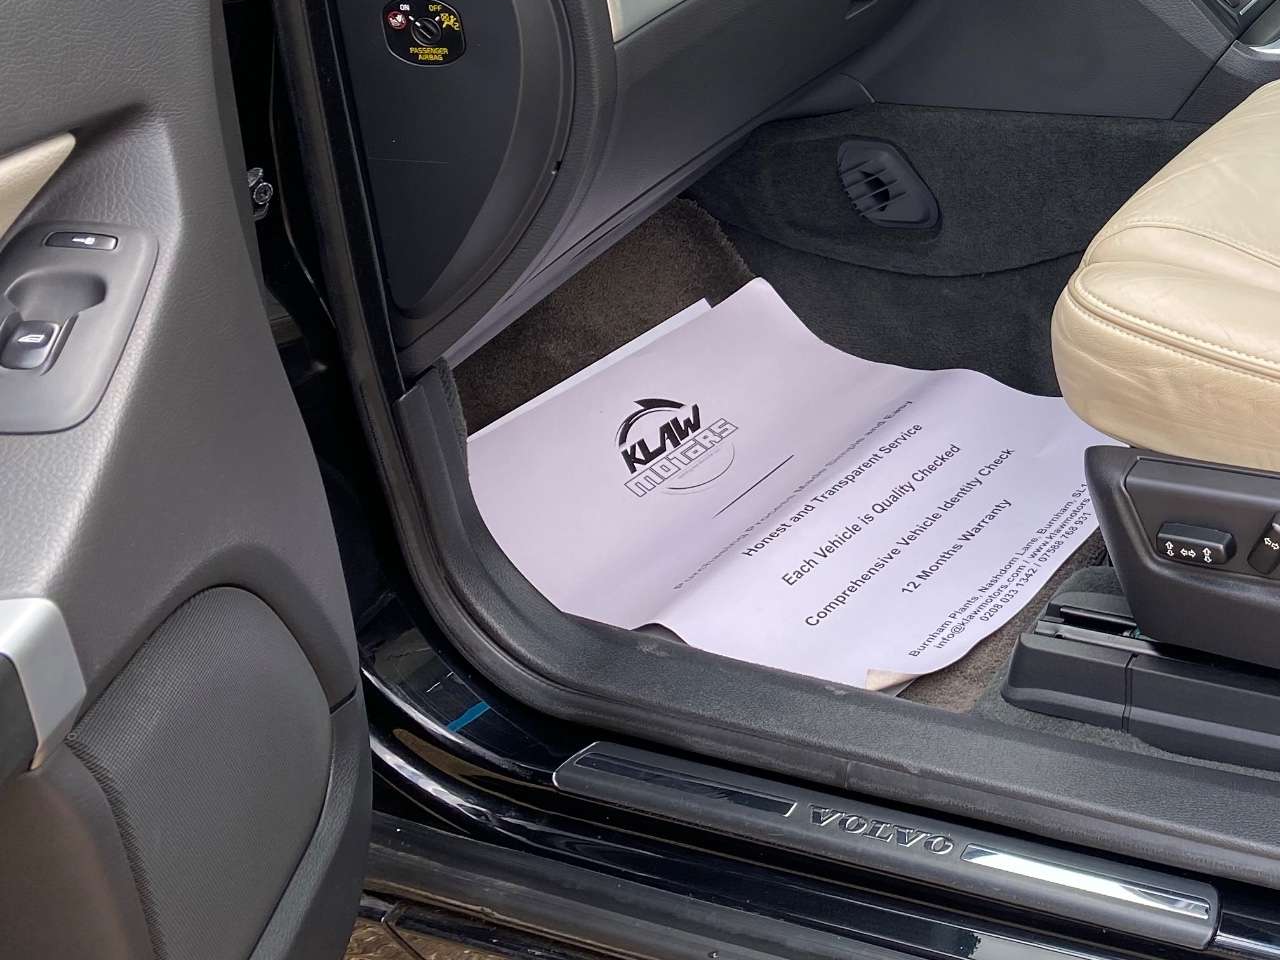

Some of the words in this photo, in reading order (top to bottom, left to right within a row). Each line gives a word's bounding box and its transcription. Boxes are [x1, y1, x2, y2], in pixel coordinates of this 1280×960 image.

[428, 4, 442, 12] OFF
[409, 47, 449, 55] PASSENGER
[621, 403, 701, 474] KLAW
[742, 522, 792, 557] Honest
[790, 504, 816, 524] and
[811, 453, 883, 503] Transparent
[879, 424, 922, 454] Service
[781, 558, 818, 587] Each
[813, 522, 862, 559] Vehicle
[857, 513, 875, 526] is
[871, 480, 916, 515] Quality
[911, 443, 961, 482] Checked
[805, 545, 901, 627] Comprehensive
[896, 511, 942, 547] Vehicle
[937, 476, 983, 513] Identity
[978, 447, 1015, 477] Check
[901, 580, 922, 594] 12
[915, 543, 963, 581] Months
[957, 498, 1012, 542] Warranty
[908, 616, 952, 658] Burnham
[949, 594, 984, 620] Plants,
[977, 554, 1019, 593] Nashdom
[933, 564, 1026, 649] info@klawmotors.com
[979, 603, 1003, 623] 0208
[1000, 588, 1019, 604] 033
[1016, 567, 1038, 589] 1342
[808, 803, 954, 855] VOLVO
